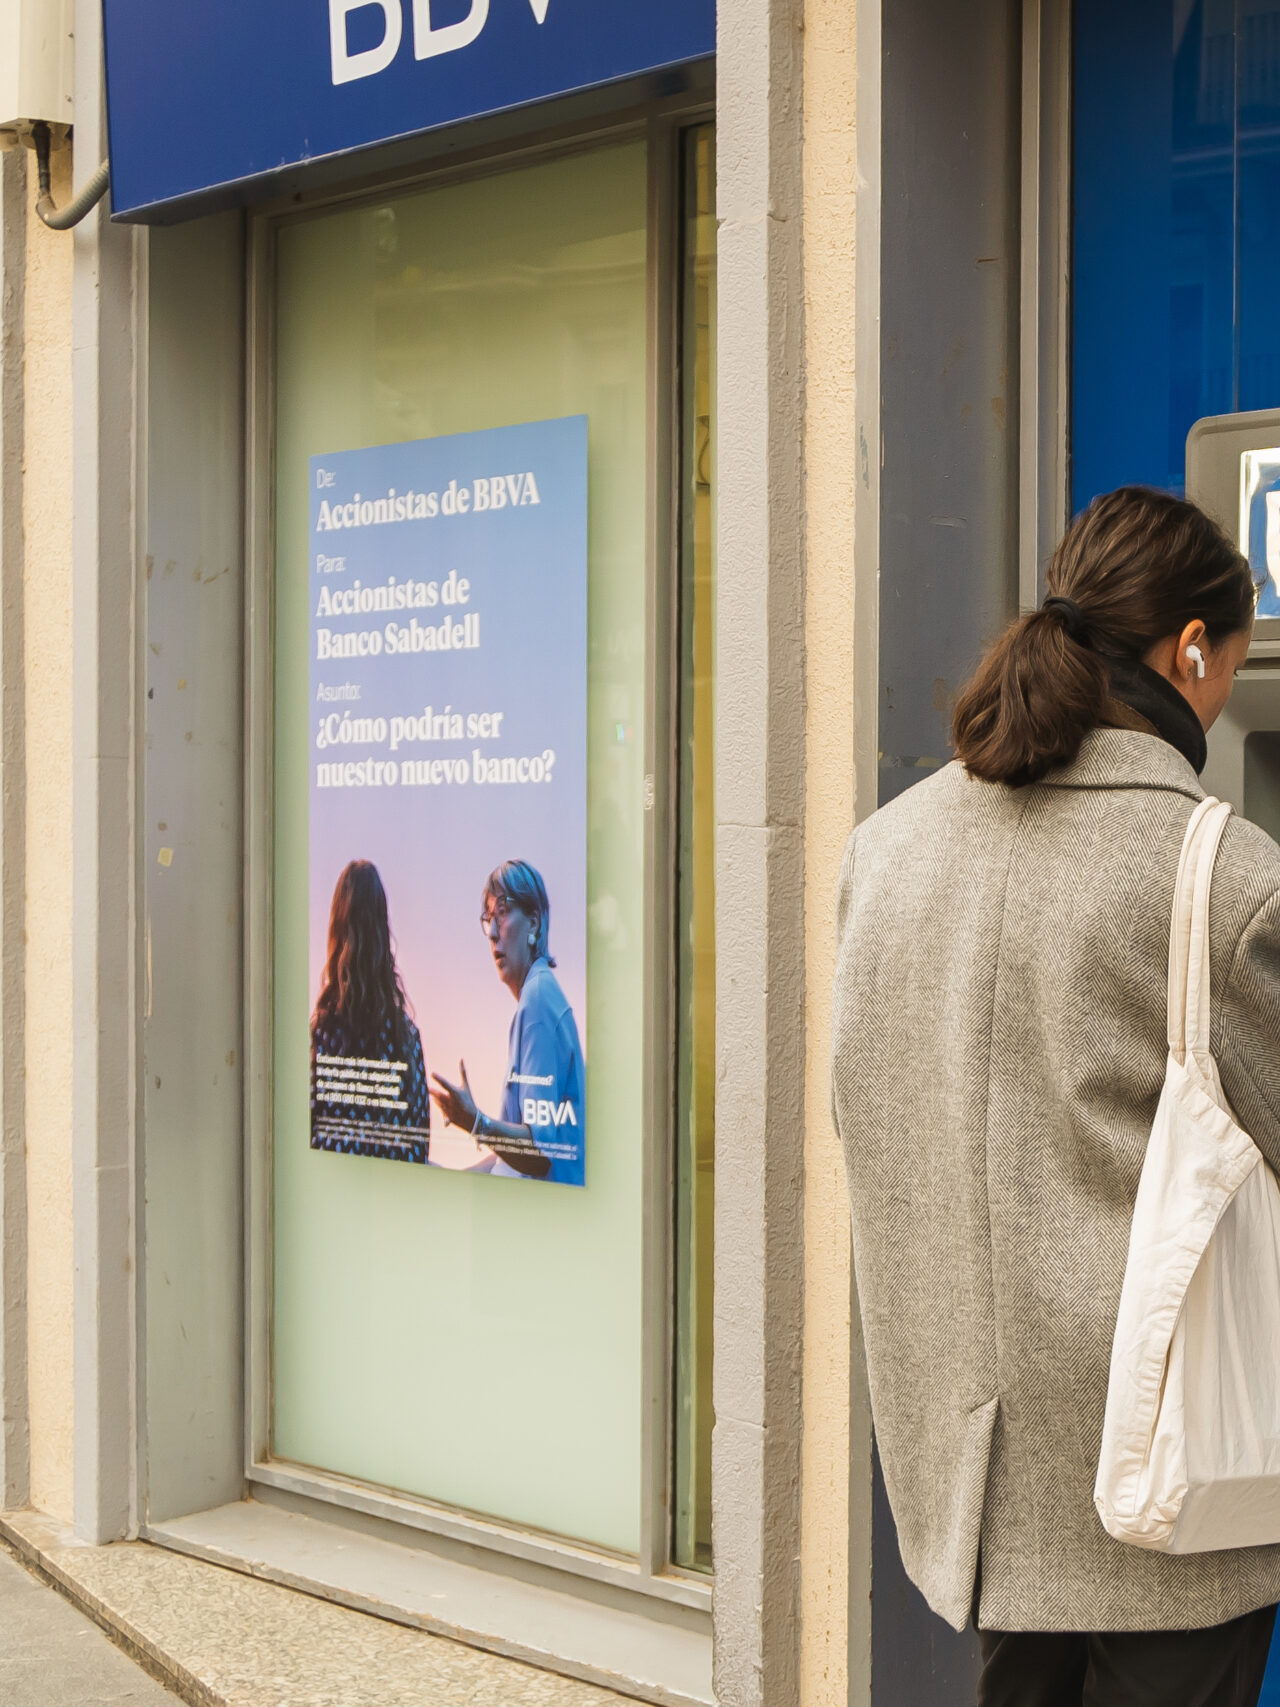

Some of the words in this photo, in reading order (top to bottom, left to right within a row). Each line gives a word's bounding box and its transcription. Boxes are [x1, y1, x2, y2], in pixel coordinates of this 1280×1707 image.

[315, 488, 440, 532] Accionistas
[441, 479, 471, 516] de
[472, 471, 541, 513] BBVA
[315, 576, 439, 617] Accionistas
[441, 569, 471, 605] de
[316, 627, 383, 660] Banco
[384, 613, 481, 655] Sabadell
[316, 710, 388, 749] ¿Cómo
[390, 705, 465, 751] podría
[466, 710, 504, 739] ser
[316, 757, 398, 788] nuestro
[400, 758, 471, 786] nuevo
[472, 749, 556, 784] banco?
[523, 1098, 578, 1127] BBVA
